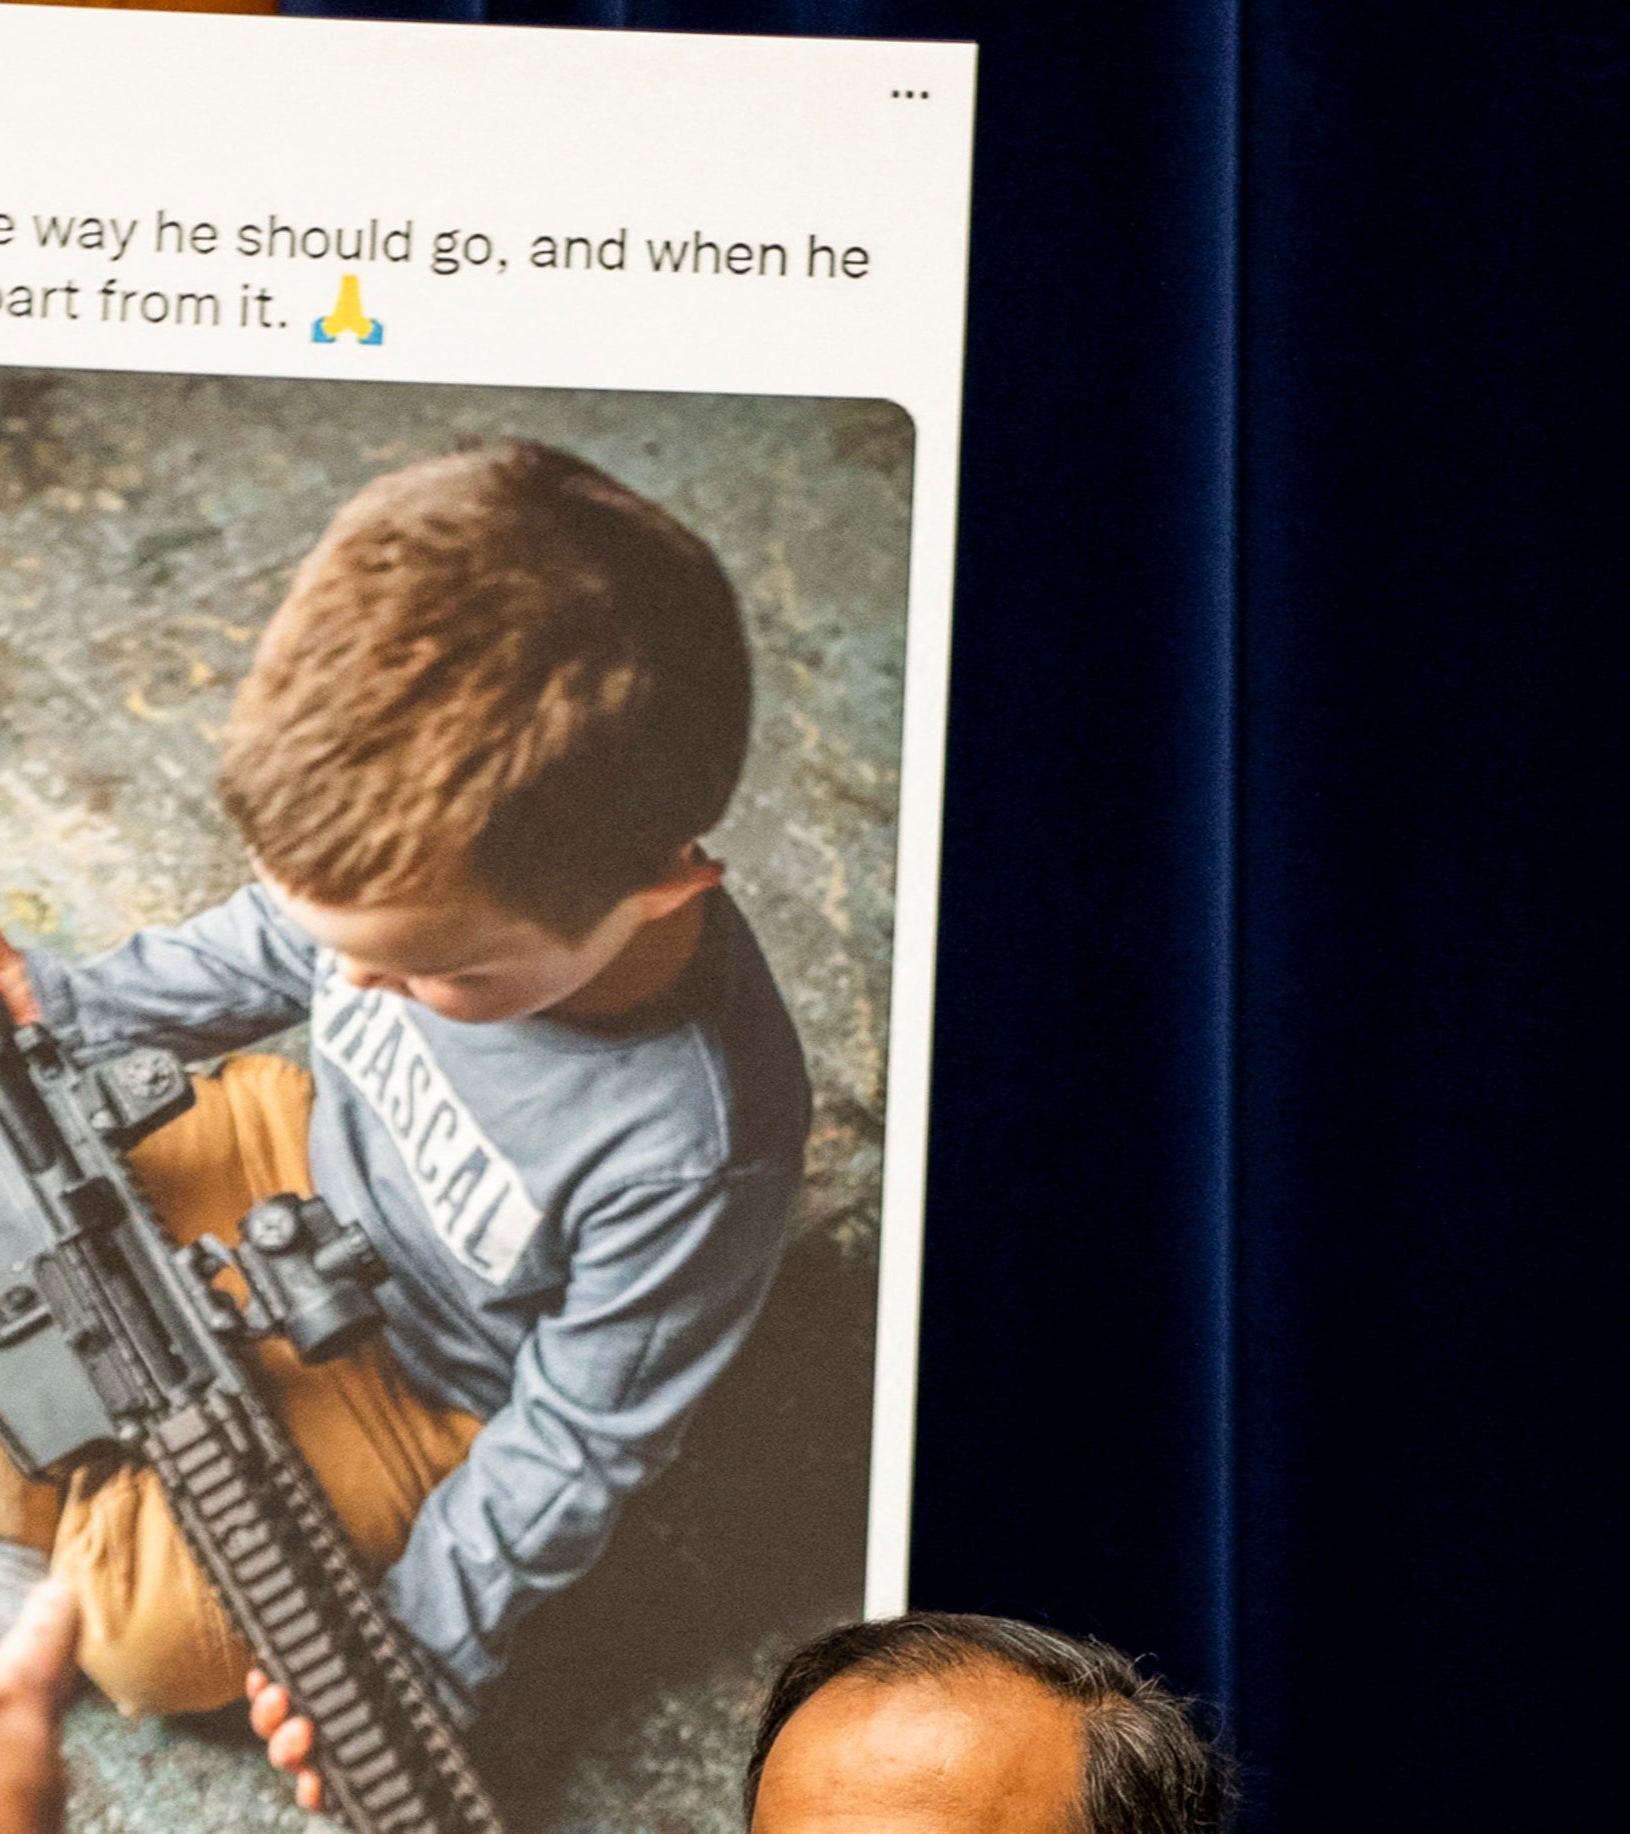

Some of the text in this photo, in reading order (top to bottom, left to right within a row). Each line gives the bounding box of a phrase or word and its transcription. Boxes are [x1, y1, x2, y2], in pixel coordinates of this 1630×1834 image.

[31, 213, 140, 264] way
[154, 208, 220, 257] he
[235, 212, 415, 265] should
[428, 228, 510, 276] go,
[528, 226, 629, 273] and
[644, 229, 789, 278] when
[805, 232, 872, 280] he
[96, 276, 221, 330] from
[239, 282, 290, 330] it.
